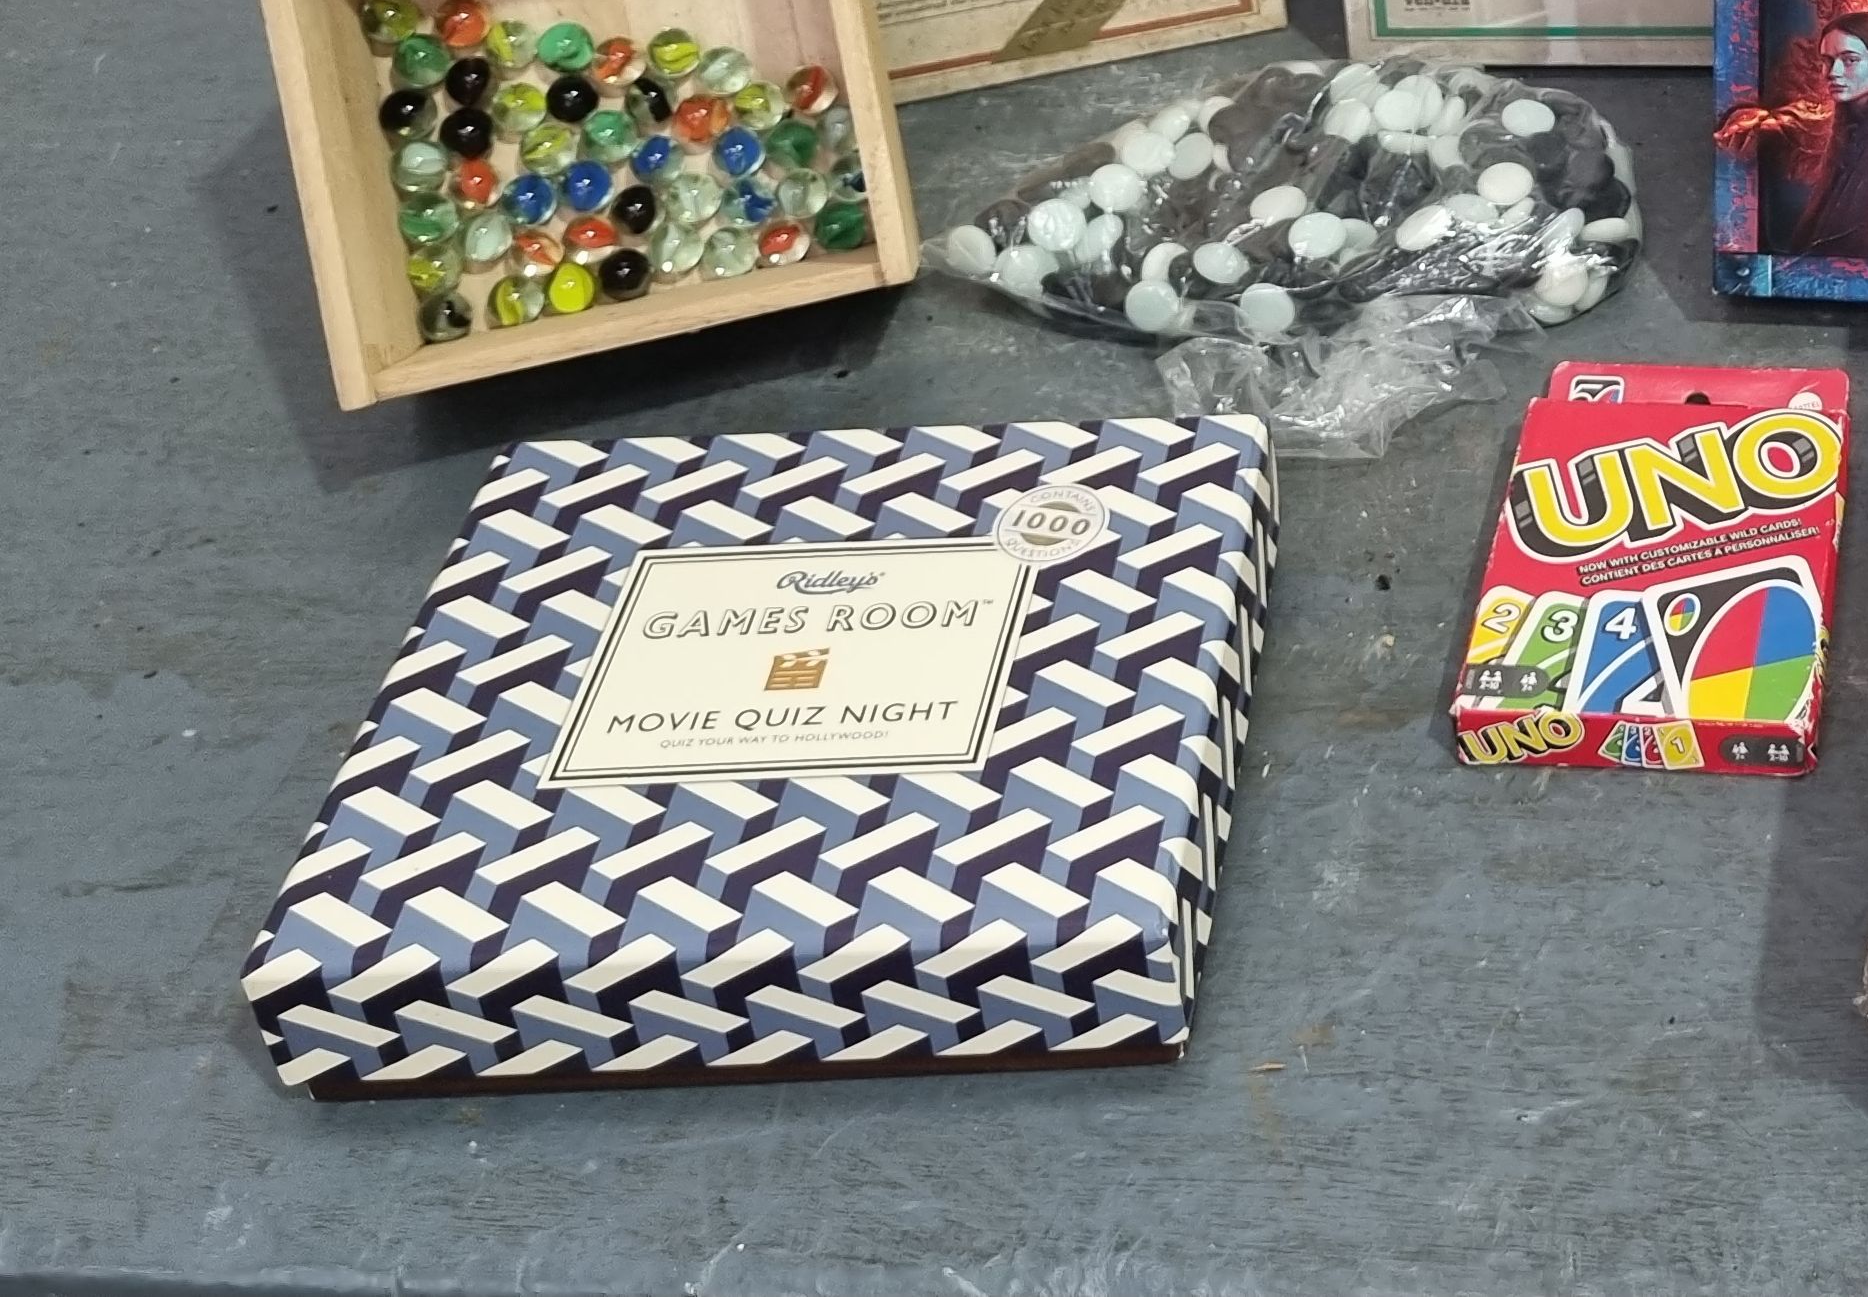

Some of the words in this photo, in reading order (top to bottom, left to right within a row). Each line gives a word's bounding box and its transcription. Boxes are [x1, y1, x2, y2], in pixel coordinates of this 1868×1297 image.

[1029, 490, 1097, 513] CONTAINS
[1510, 410, 1842, 557] UNO
[1011, 509, 1092, 536] 1000
[1578, 563, 1608, 575] NOW
[1610, 554, 1639, 569] WITH
[1641, 535, 1729, 563] CUSTOMIZABLE
[1730, 528, 1759, 542] WILD
[1760, 518, 1803, 535] CARDS!
[1581, 568, 1641, 586] CONTIENT
[1642, 561, 1667, 574] DES
[1667, 551, 1713, 569] CARTES
[1725, 526, 1820, 554] PERSONNALISER!
[776, 569, 882, 595] Ridley's
[642, 604, 810, 641] GAMES
[825, 598, 980, 633] ROOM
[606, 709, 722, 735] MOVIE
[733, 705, 828, 732] QUIZ
[839, 700, 961, 726] NIGHT
[659, 737, 697, 750] QUIZ
[698, 735, 736, 748] YOUR
[738, 734, 770, 746] WAY
[771, 733, 792, 744] TO
[794, 730, 890, 744] HOLLYWOOD!
[1459, 711, 1583, 764] UNO
